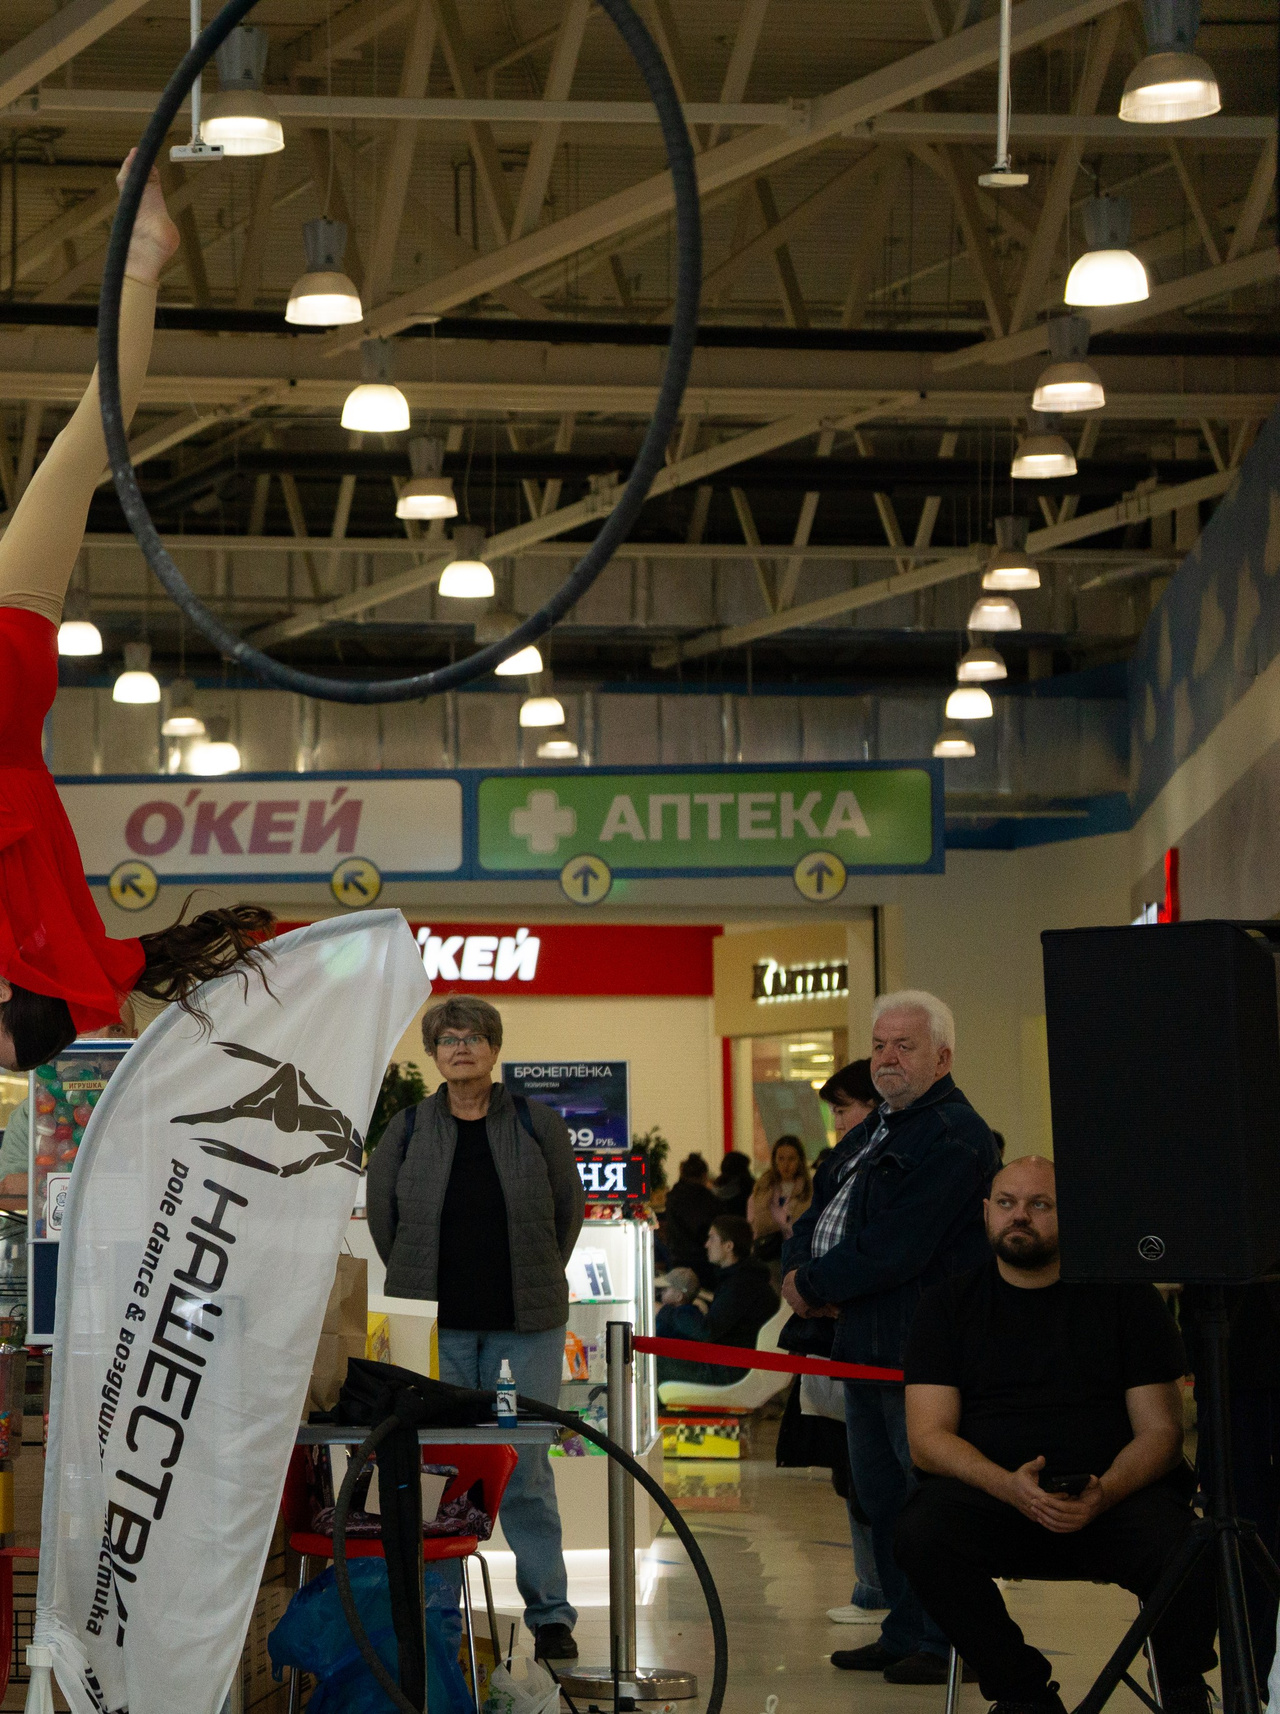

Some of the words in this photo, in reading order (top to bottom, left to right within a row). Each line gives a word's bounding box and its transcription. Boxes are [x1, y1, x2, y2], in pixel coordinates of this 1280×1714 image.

[124, 786, 363, 857] О'КЕЙ
[599, 790, 871, 842] АПТЕКА
[414, 926, 541, 982] 'КЕЙ
[513, 1063, 613, 1078] БРОНЕПЛЁНКА
[158, 1157, 191, 1218] pole
[575, 1162, 628, 1192] НЯ
[133, 1221, 172, 1299] dance
[124, 1302, 147, 1323] &
